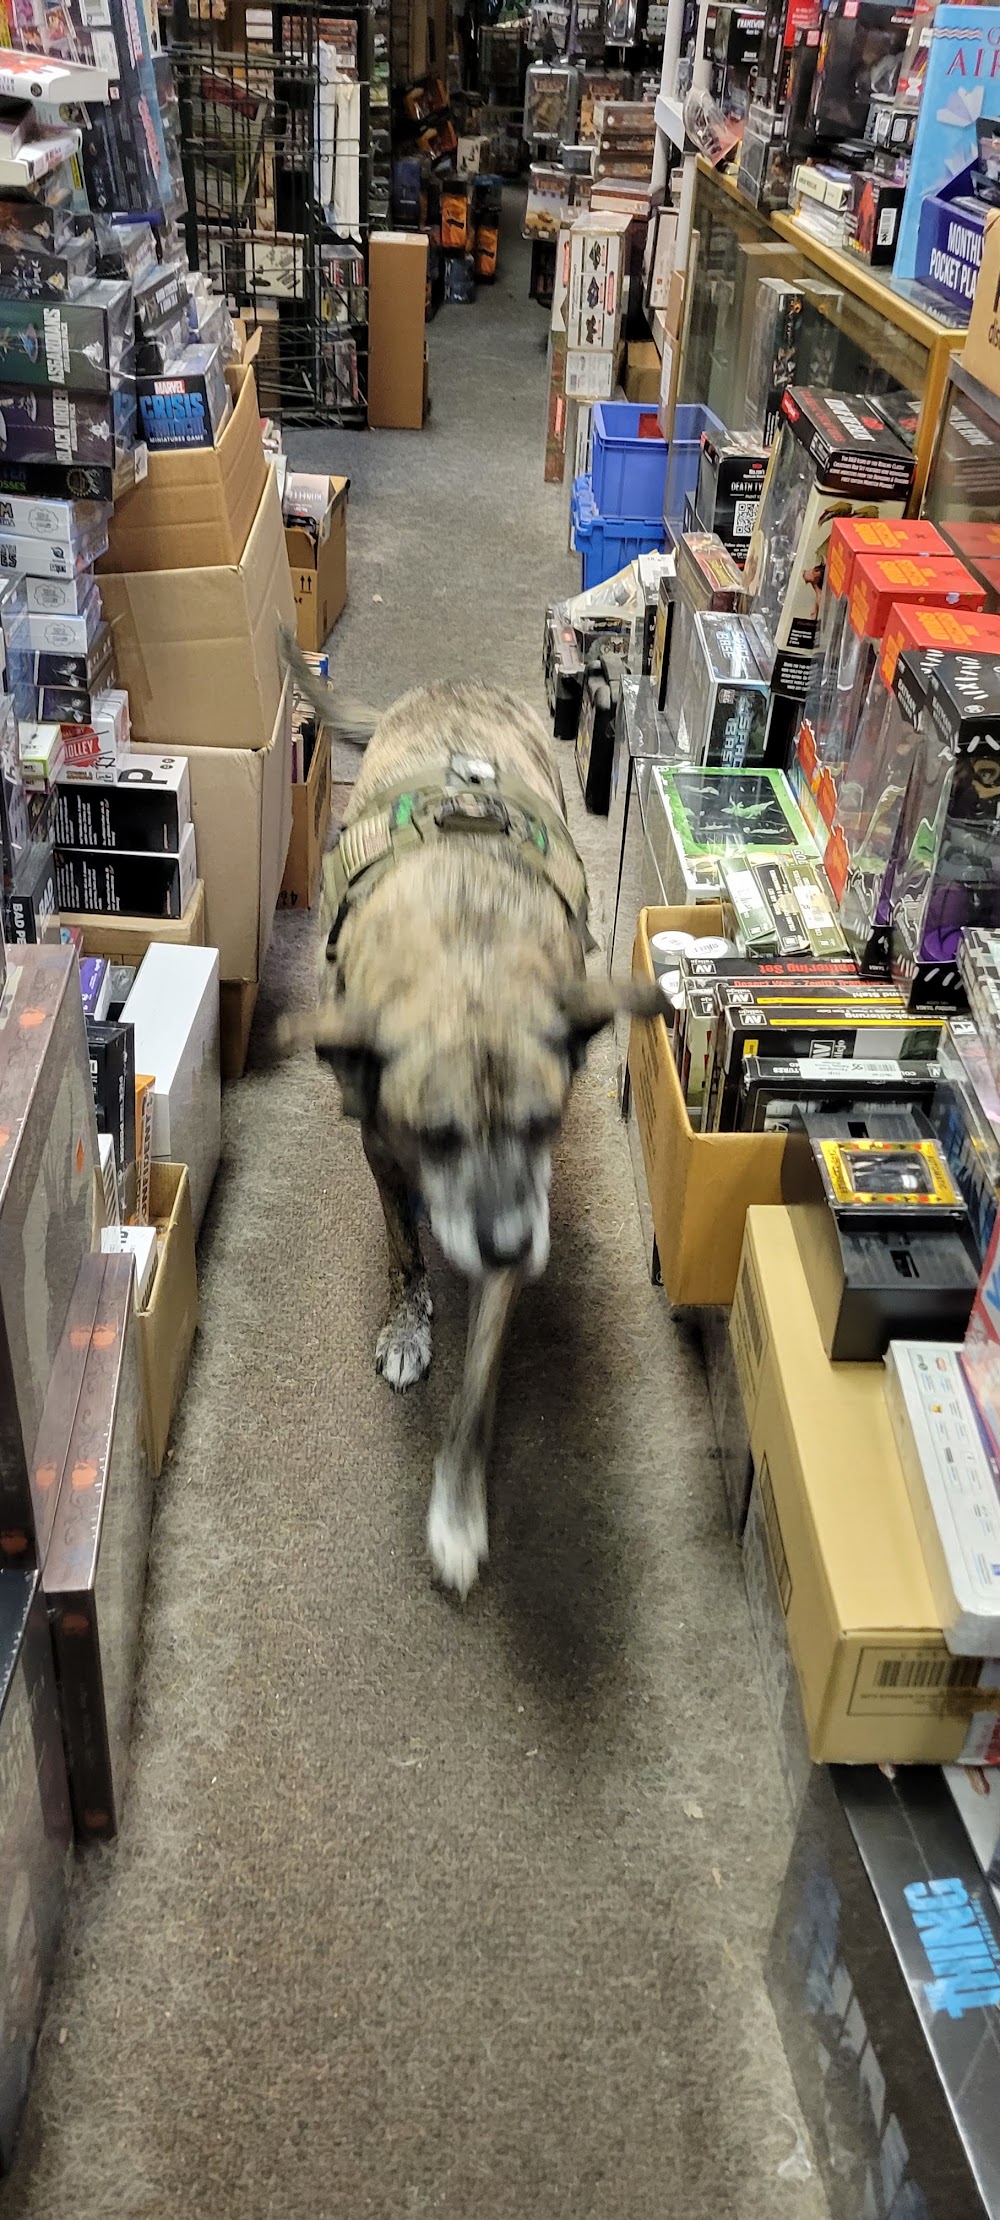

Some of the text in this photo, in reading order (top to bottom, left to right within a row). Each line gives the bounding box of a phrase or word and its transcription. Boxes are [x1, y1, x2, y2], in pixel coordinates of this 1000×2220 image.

[929, 247, 961, 290] POCKET
[43, 307, 65, 384] ASGARDIANS
[154, 379, 186, 395] MARVEL
[140, 392, 205, 420] CRISIS
[149, 434, 204, 444] MINIATURES GAME
[731, 481, 753, 492] DEATH
[716, 630, 733, 659] BASE
[12, 902, 26, 930] BAD
[759, 963, 783, 975] Set
[852, 991, 878, 999] Stahl
